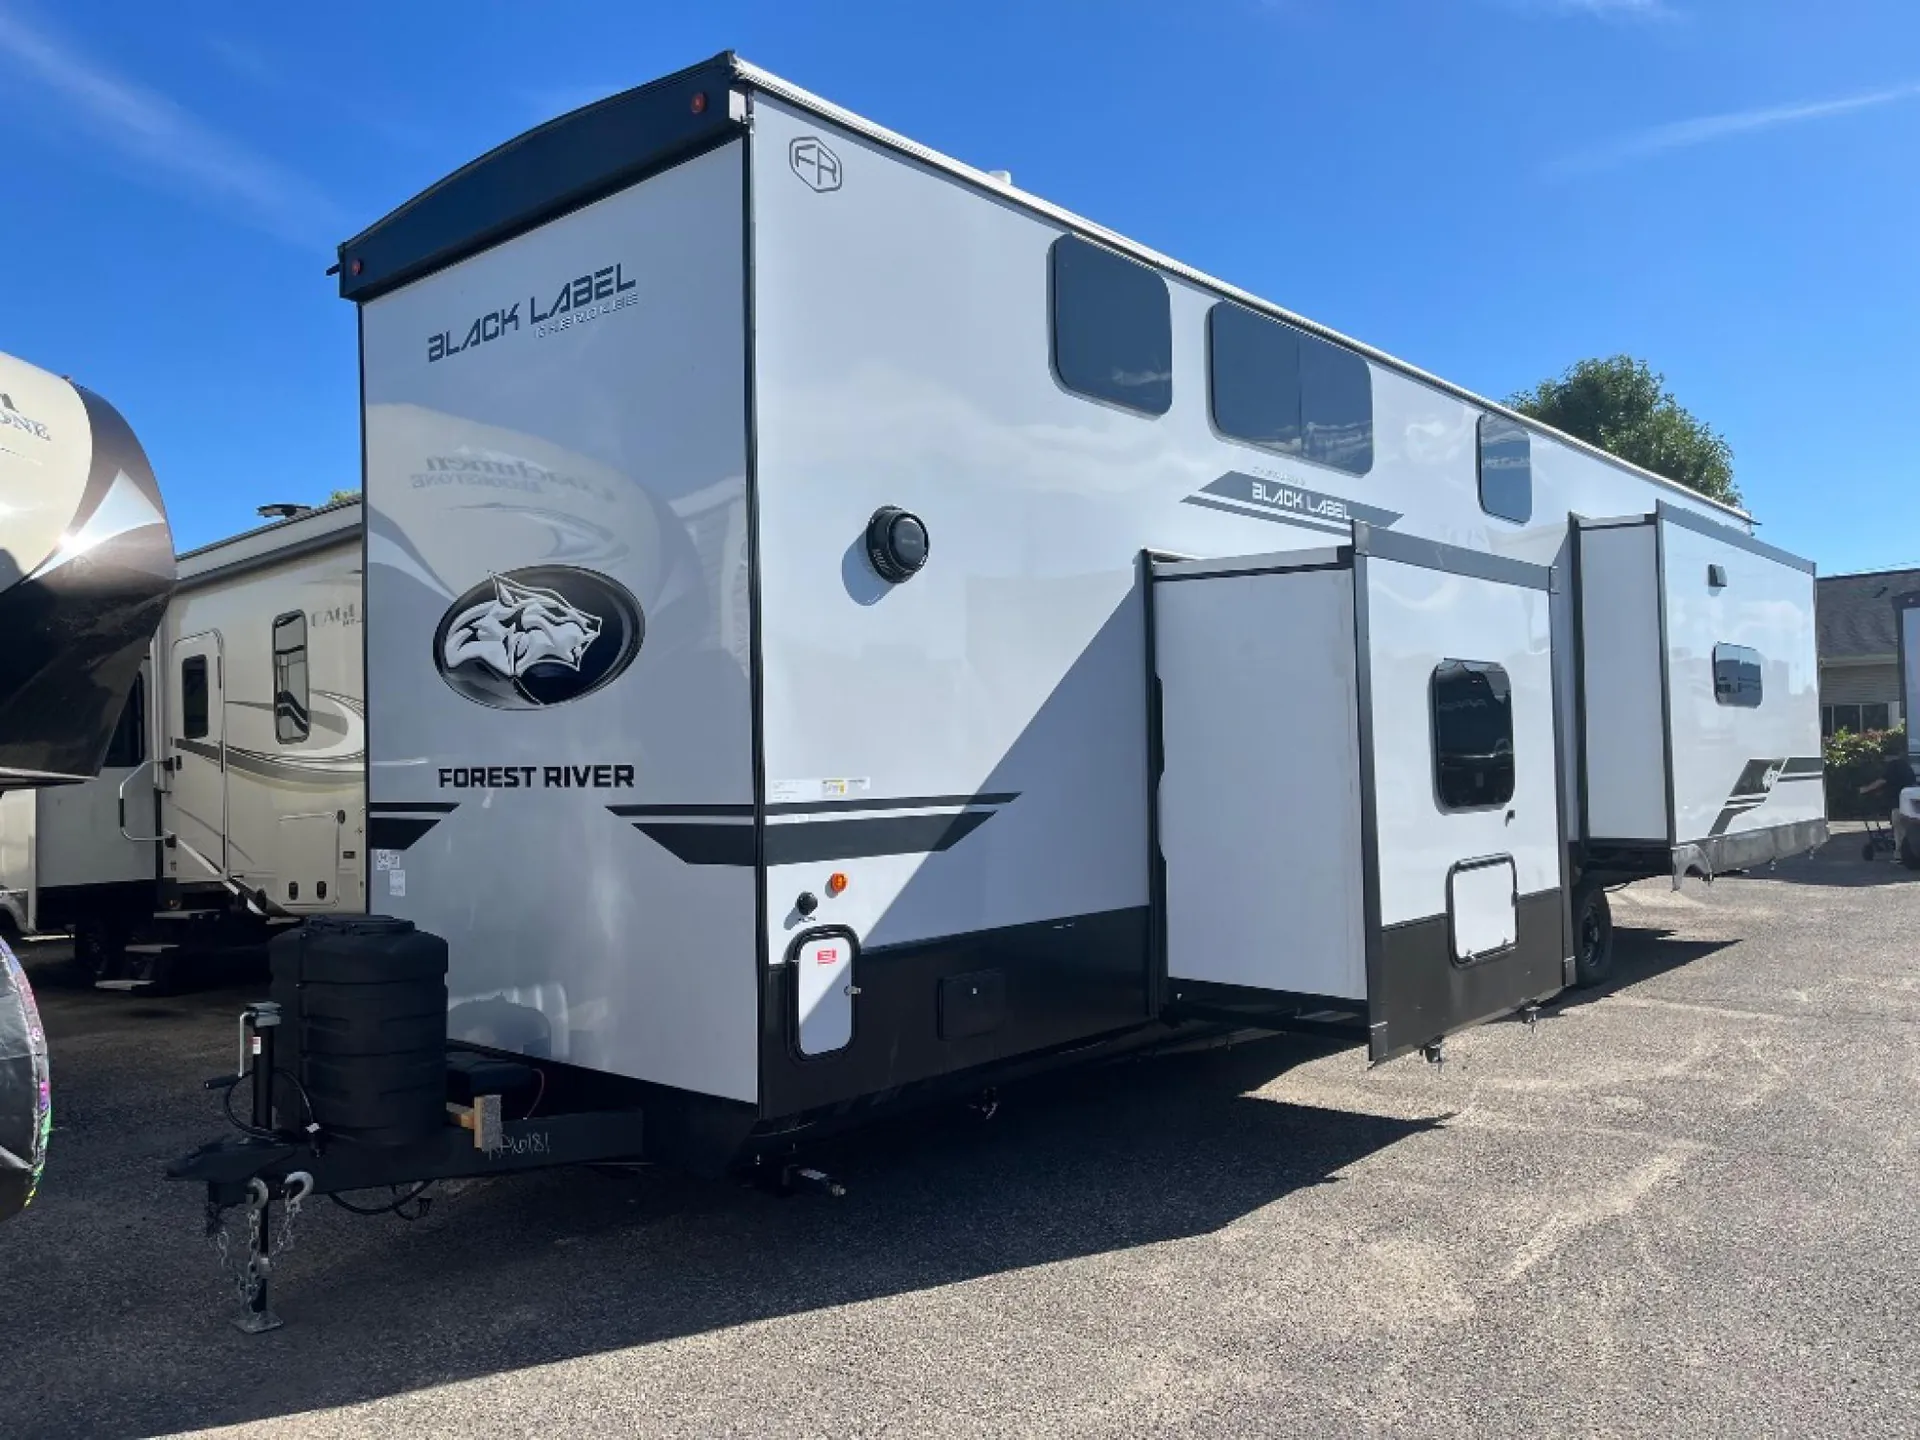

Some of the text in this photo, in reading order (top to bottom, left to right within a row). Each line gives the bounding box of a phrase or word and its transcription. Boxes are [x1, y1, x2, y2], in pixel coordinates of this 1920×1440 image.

[427, 262, 637, 363] BLACK LABEL
[1252, 481, 1352, 520] BLACK LABEL
[438, 764, 635, 788] FOREST RIVER
